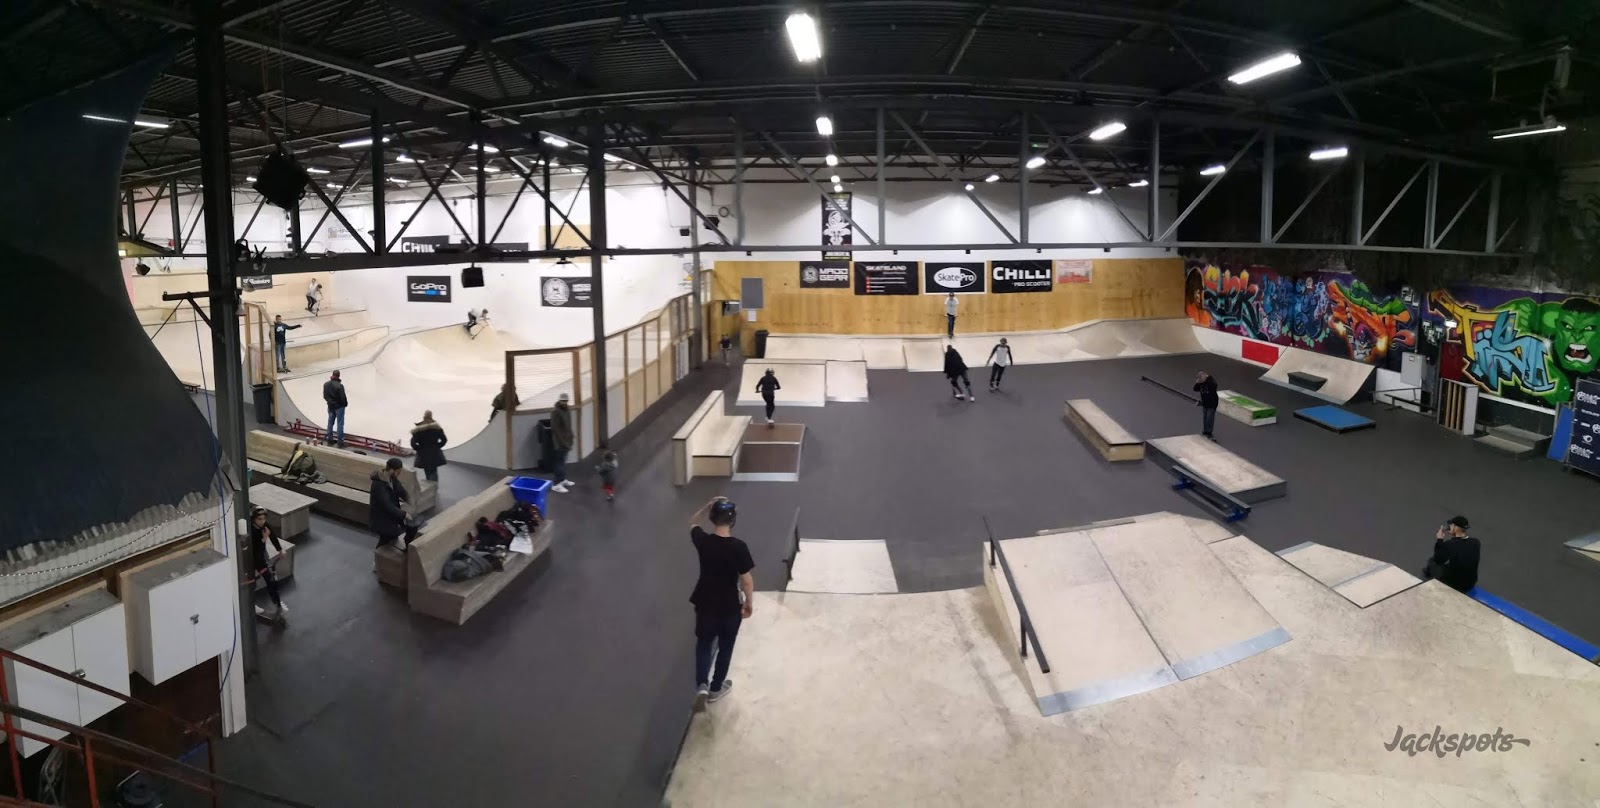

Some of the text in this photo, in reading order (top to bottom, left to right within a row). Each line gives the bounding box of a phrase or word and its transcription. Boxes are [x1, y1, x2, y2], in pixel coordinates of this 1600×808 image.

[938, 273, 975, 282] SkatePro
[992, 266, 1051, 281] CHILLI
[410, 282, 447, 290] GoPro
